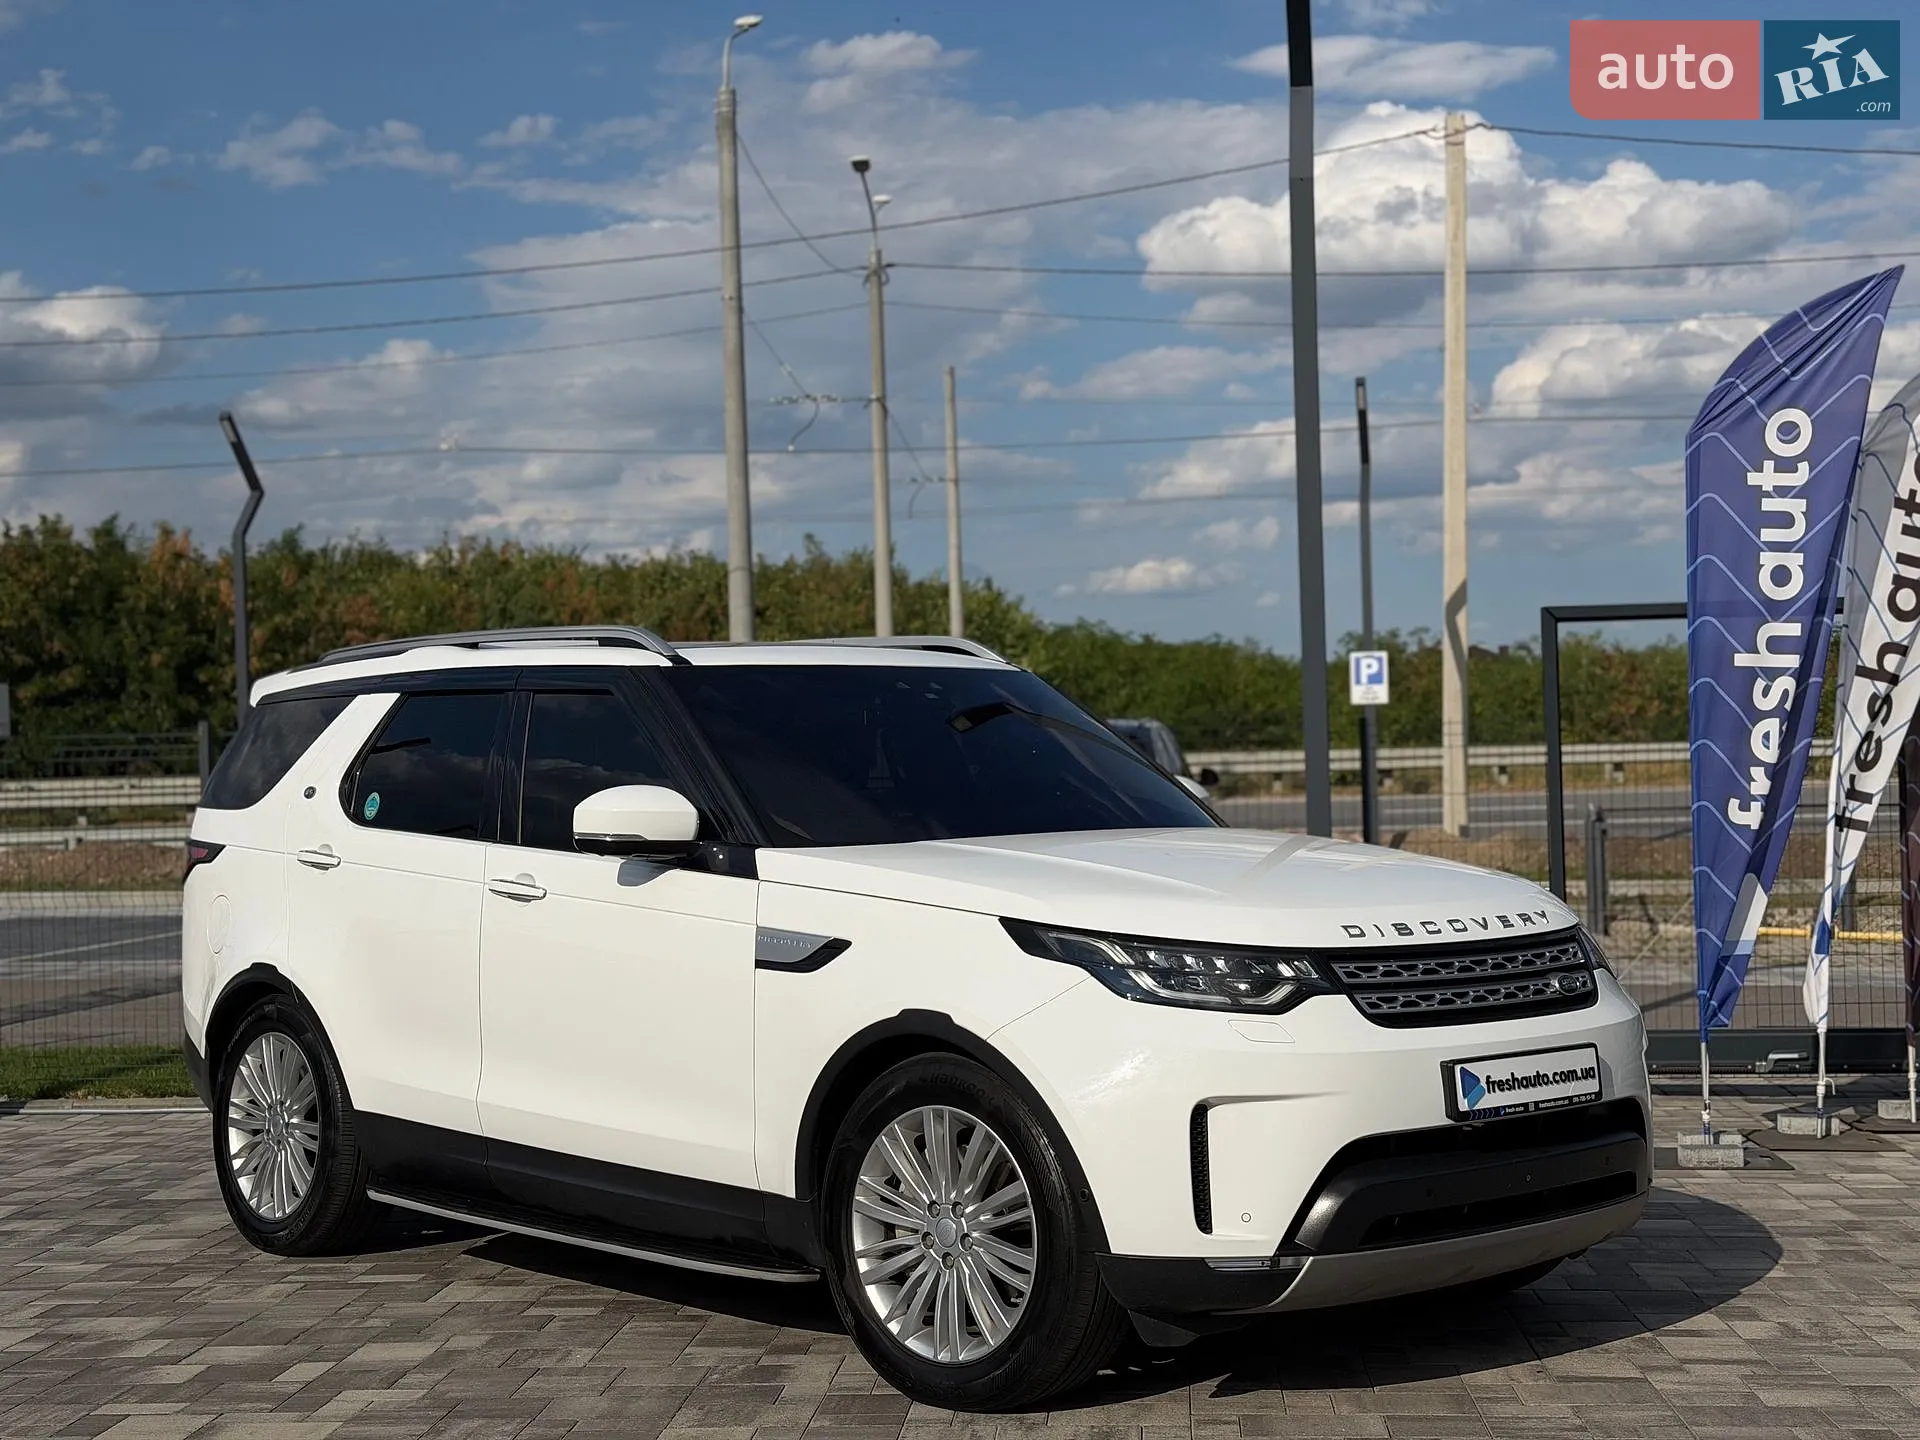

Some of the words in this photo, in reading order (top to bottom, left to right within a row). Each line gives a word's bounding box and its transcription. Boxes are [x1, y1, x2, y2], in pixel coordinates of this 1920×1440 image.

[1746, 408, 1813, 601] auto
[1360, 656, 1380, 684] P
[1834, 641, 1910, 833] fresh
[1886, 452, 1920, 622] aut
[1727, 622, 1802, 830] fresh
[1339, 910, 1550, 939] DISCOVERY
[1485, 1066, 1596, 1094] freshauto.com.ua
